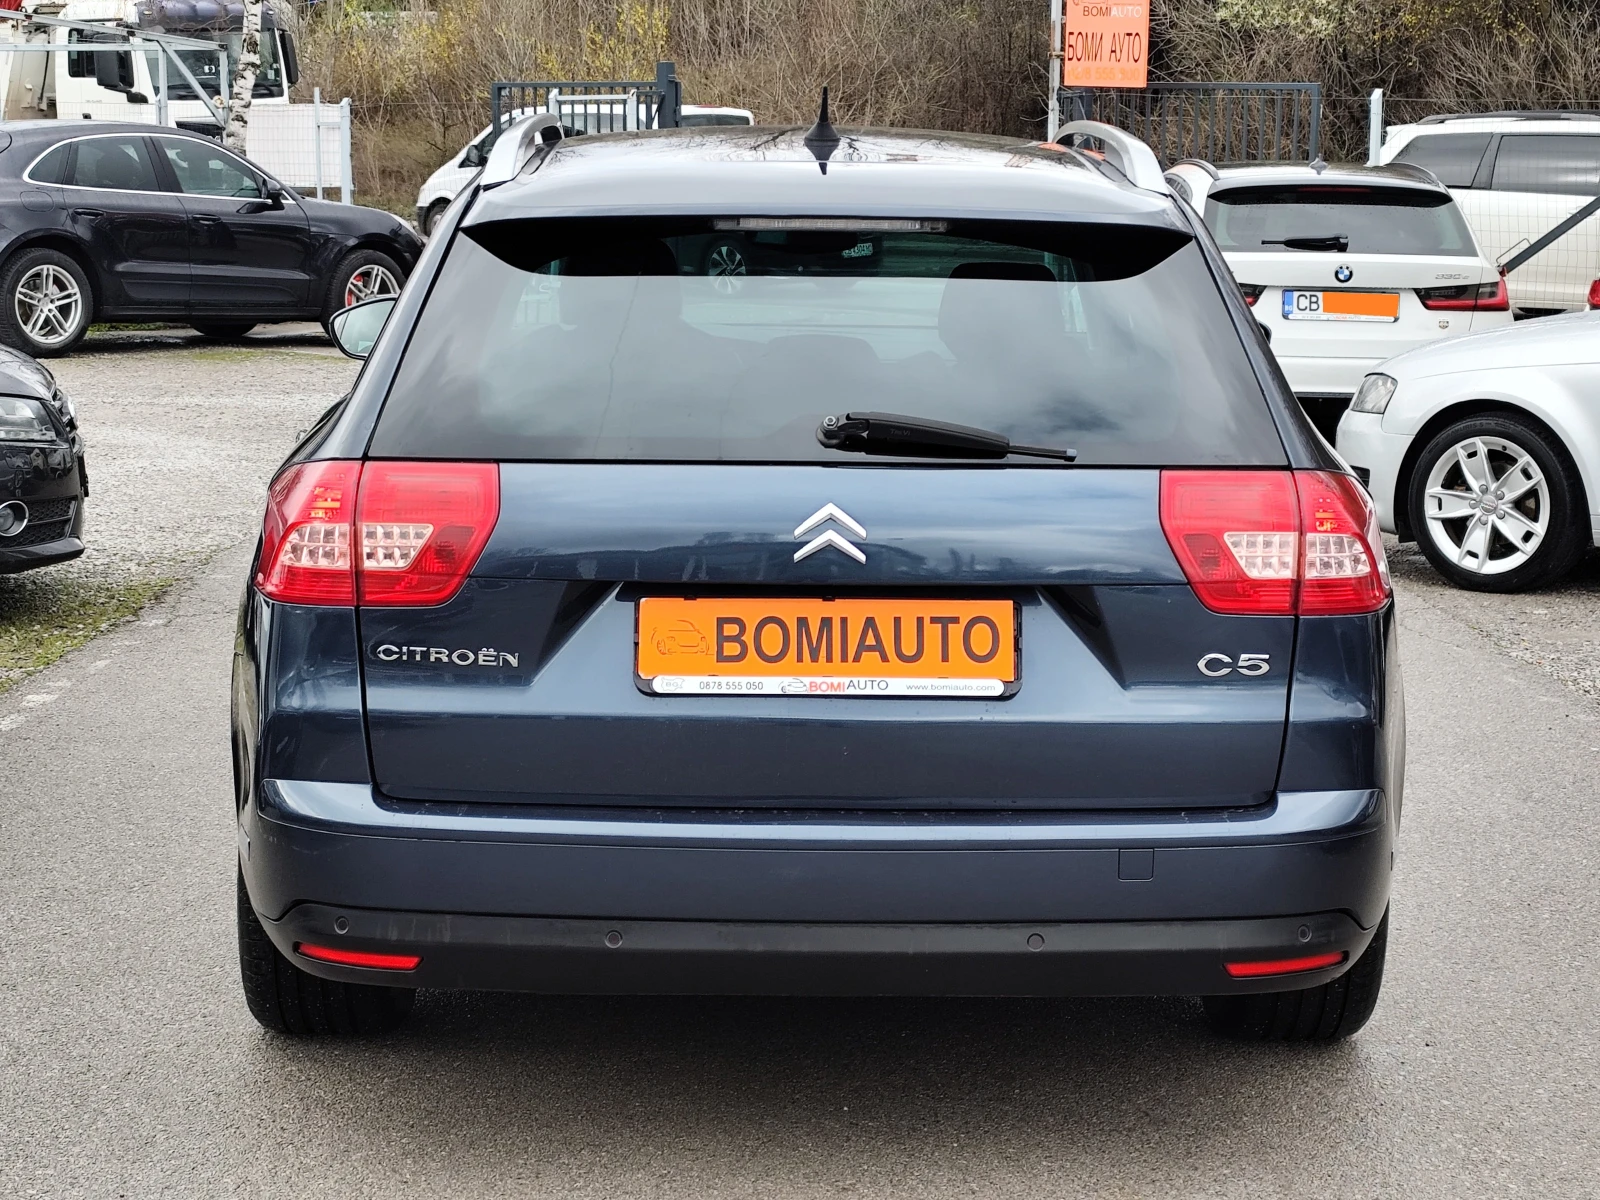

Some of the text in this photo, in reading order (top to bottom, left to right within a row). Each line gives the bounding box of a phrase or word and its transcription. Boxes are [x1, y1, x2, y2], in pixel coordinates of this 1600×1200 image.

[1083, 6, 1142, 18] BOMIAUTO
[1067, 31, 1142, 63] БОМИ АУТО
[716, 615, 1000, 664] BOMIAUTO
[376, 644, 519, 668] CITROËN
[1197, 653, 1270, 677] C5
[699, 681, 764, 690] 0878 555 050
[905, 683, 996, 692] www.bomiauto.com
